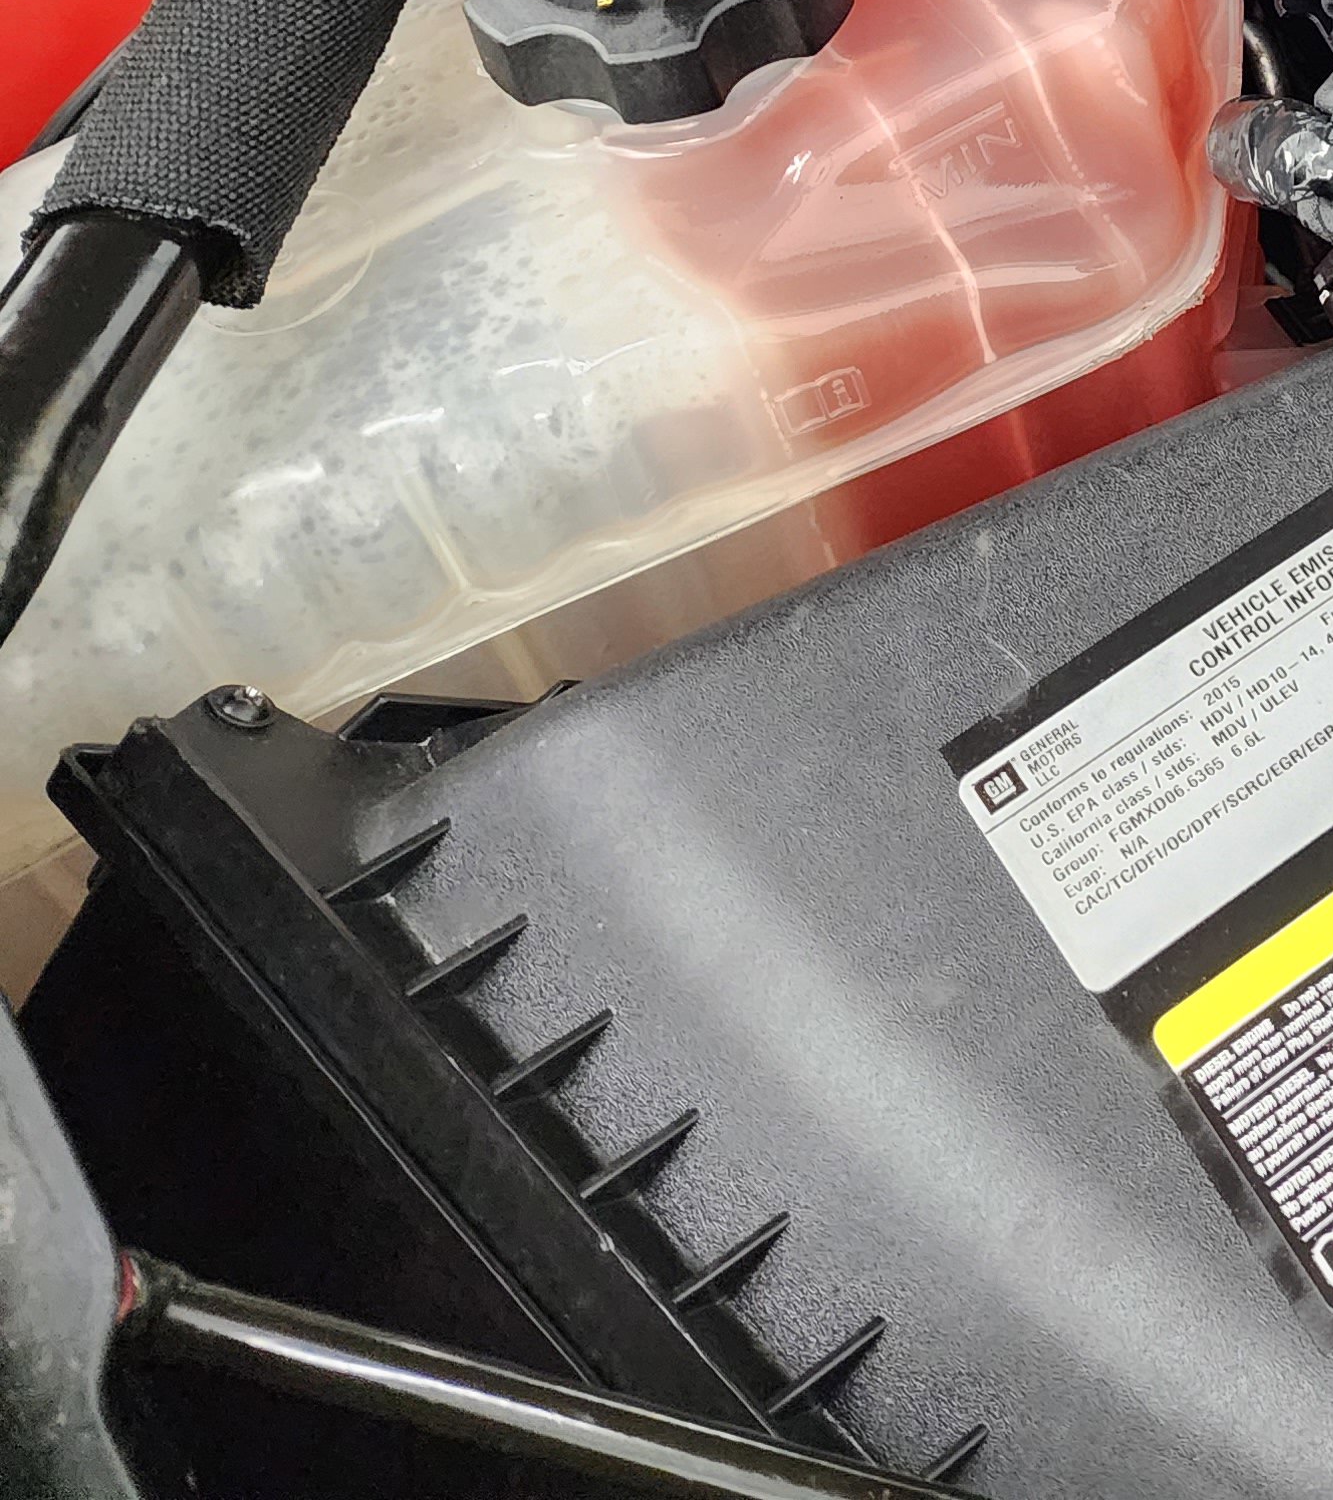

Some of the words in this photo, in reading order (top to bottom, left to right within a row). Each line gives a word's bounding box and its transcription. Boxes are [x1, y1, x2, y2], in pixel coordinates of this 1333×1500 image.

[1186, 605, 1285, 679] CONTROL
[1201, 577, 1288, 643] VEHICLE
[1017, 716, 1079, 763] GENERAL
[1017, 777, 1091, 835] Conforms
[1088, 765, 1109, 785] to
[1106, 706, 1195, 773] regulations:
[1200, 673, 1243, 708] 2015
[1026, 731, 1084, 775] MOTORS
[1028, 818, 1065, 850] U.S.
[1065, 794, 1100, 824] EPA
[1098, 767, 1140, 802] class
[1137, 759, 1151, 775] /
[1148, 734, 1188, 767] stds:
[1198, 700, 1236, 732] HDV
[1233, 693, 1247, 708] /
[1034, 763, 1062, 787] LLC
[1038, 809, 1114, 867] California
[1112, 782, 1153, 816] class
[1151, 774, 1164, 789] /
[1162, 748, 1202, 782] stds:
[1209, 714, 1250, 748] MDV
[1247, 707, 1261, 722] /
[1258, 678, 1302, 714] ULEV
[981, 769, 1015, 800] GM
[1050, 839, 1106, 886] Group:
[1106, 755, 1227, 845] FGMXD06.6365
[1228, 727, 1267, 760] 6.6L
[1061, 862, 1109, 903] Evap:
[1118, 832, 1150, 861] N/A
